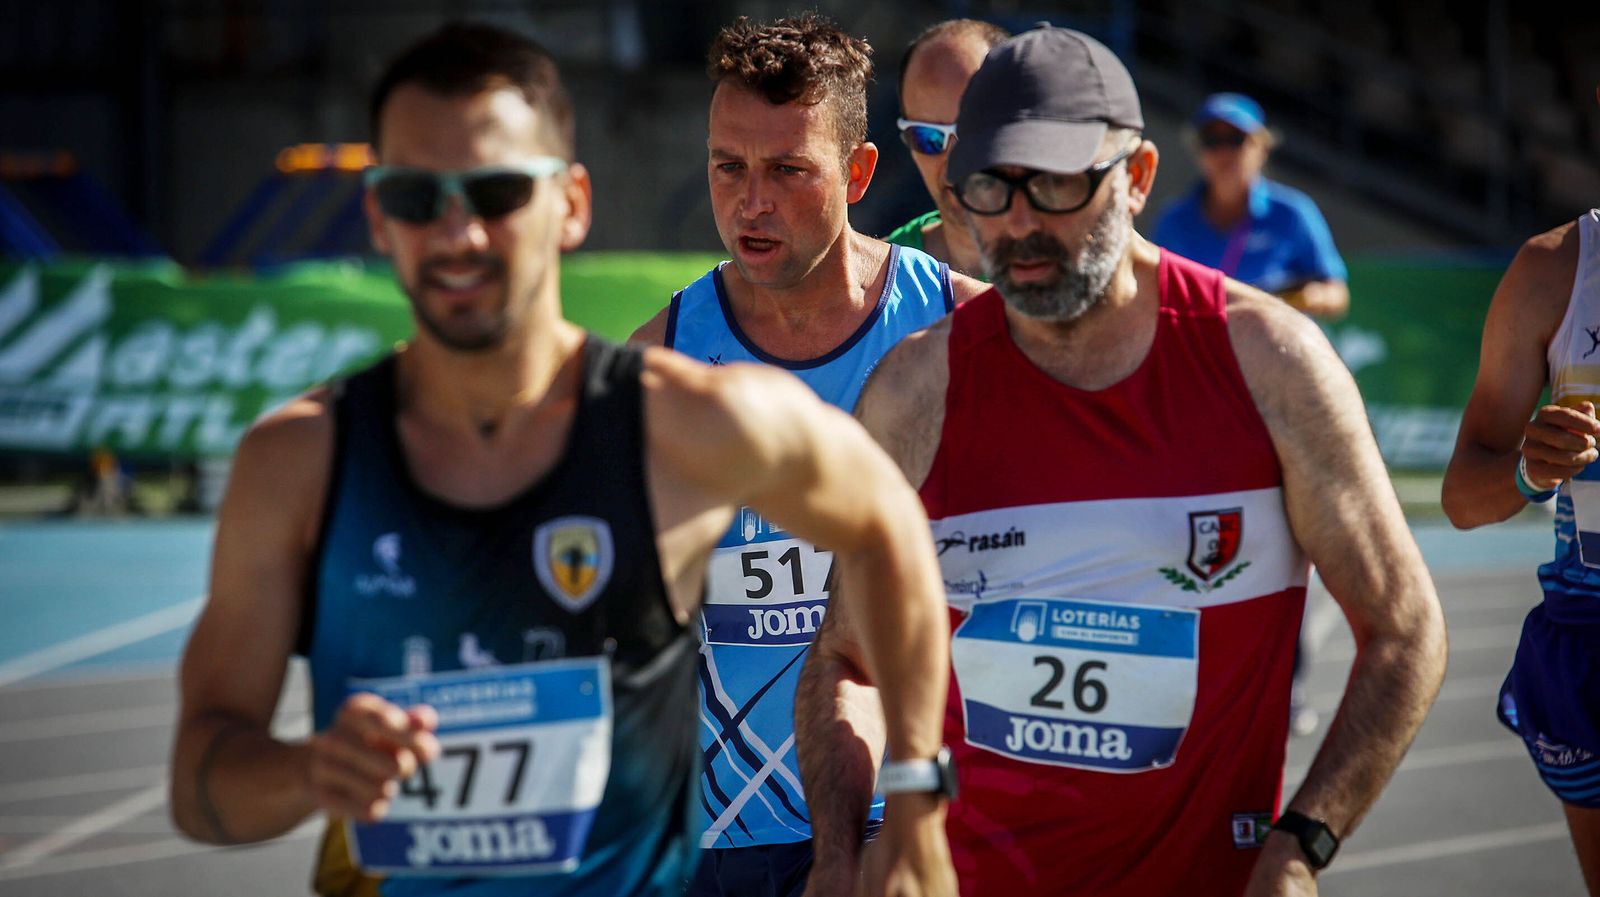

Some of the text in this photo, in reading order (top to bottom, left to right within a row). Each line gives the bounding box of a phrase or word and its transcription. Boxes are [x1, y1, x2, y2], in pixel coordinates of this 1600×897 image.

[968, 526, 1025, 552] rasán
[1051, 607, 1141, 630] LOTERÍAS
[1029, 655, 1109, 714] 26
[400, 741, 533, 809] 477
